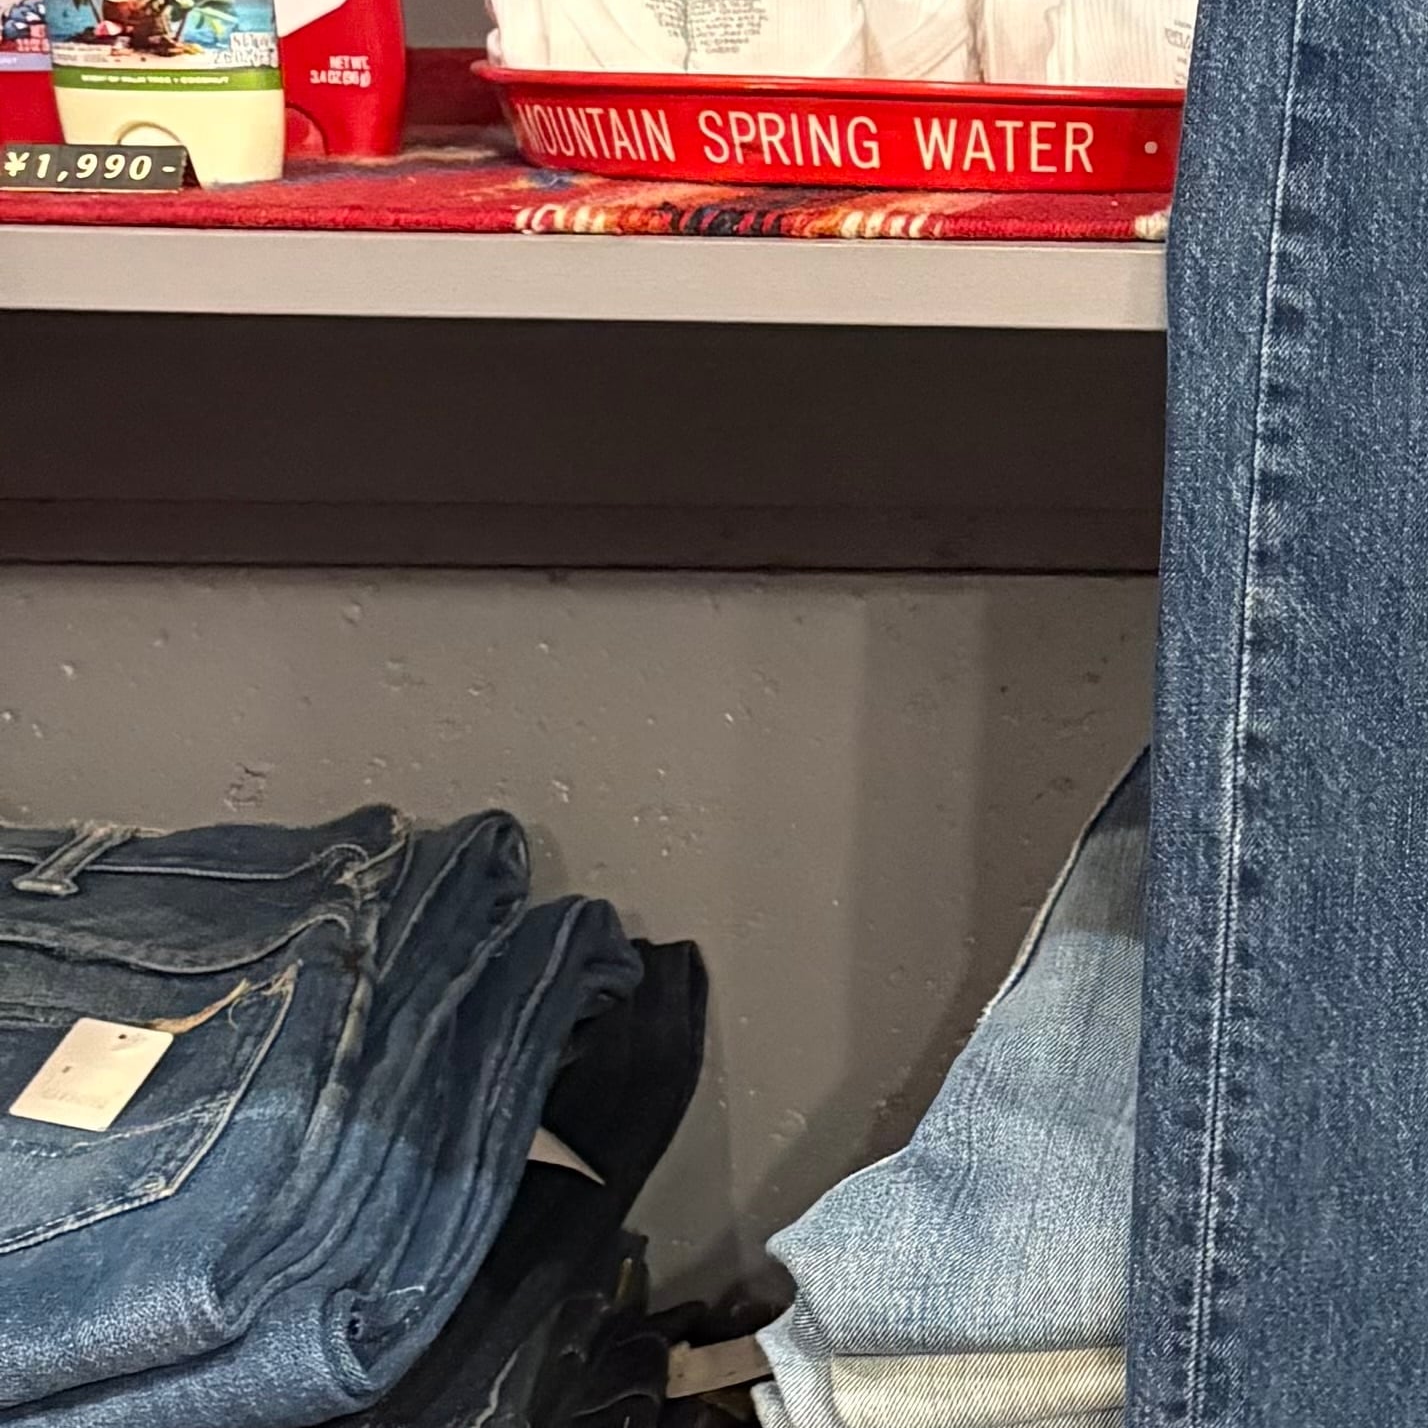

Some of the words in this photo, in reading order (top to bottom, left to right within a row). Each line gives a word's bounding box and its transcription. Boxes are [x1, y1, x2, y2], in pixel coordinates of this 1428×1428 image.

[516, 103, 676, 162] MOUNTAIN
[698, 110, 880, 170] SPRING
[913, 117, 1094, 173] WATER
